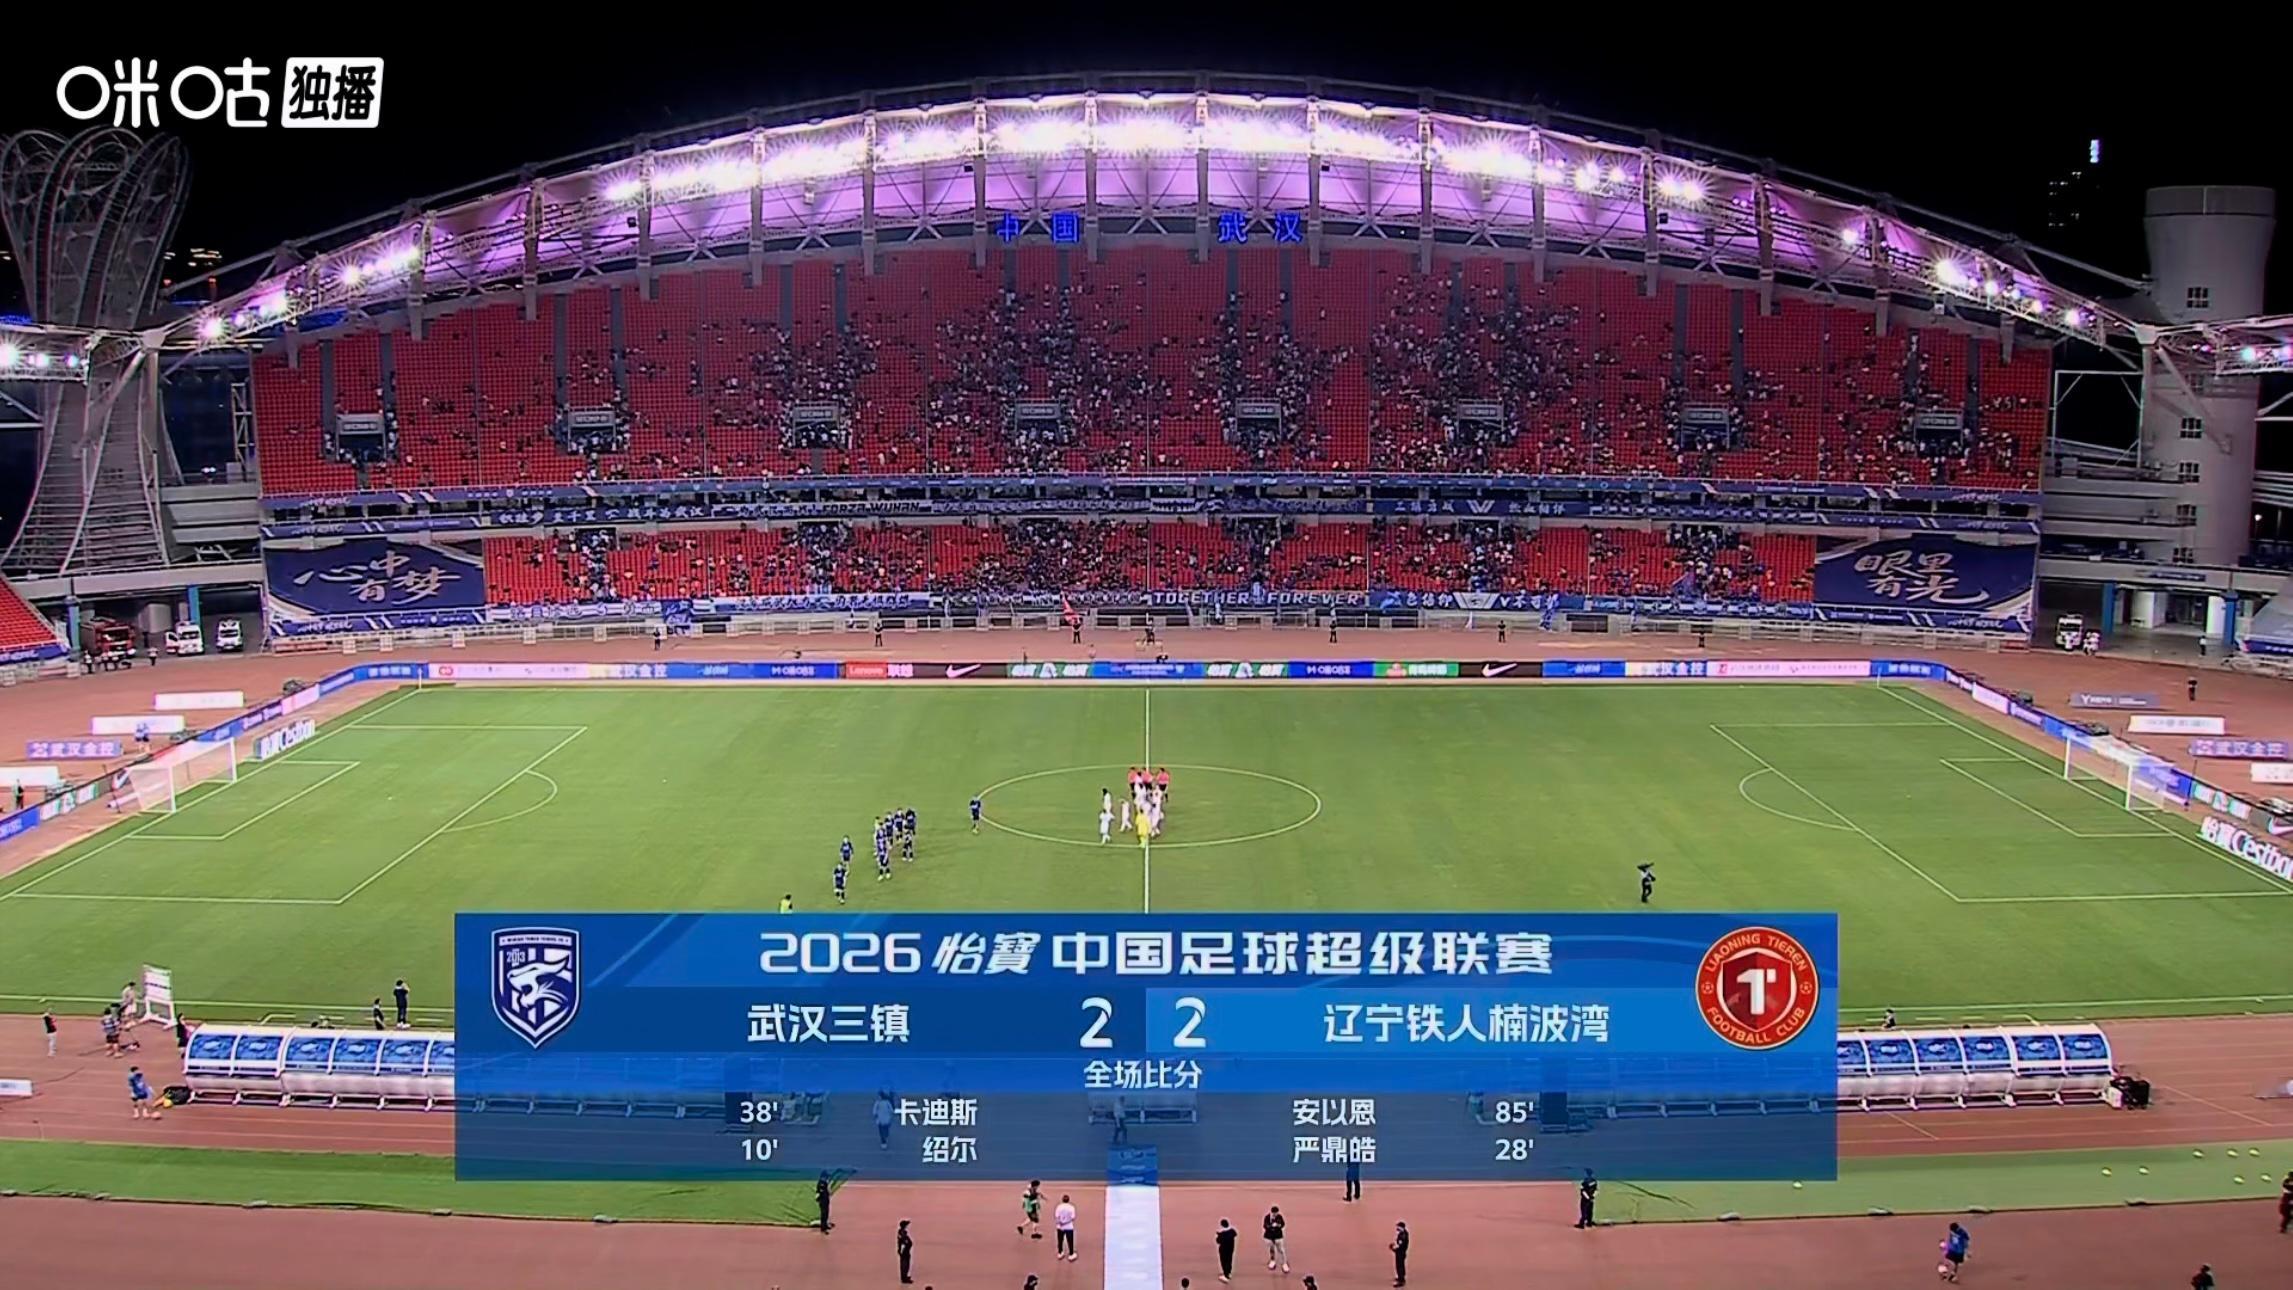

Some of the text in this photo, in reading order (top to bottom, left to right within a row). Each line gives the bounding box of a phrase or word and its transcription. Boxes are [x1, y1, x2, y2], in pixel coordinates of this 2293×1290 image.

[996, 210, 1303, 243] 中国 武汉
[822, 500, 920, 515] FORZA WUHAN
[1153, 590, 1250, 606] TOGETHER
[1267, 590, 1360, 606] FOREVER
